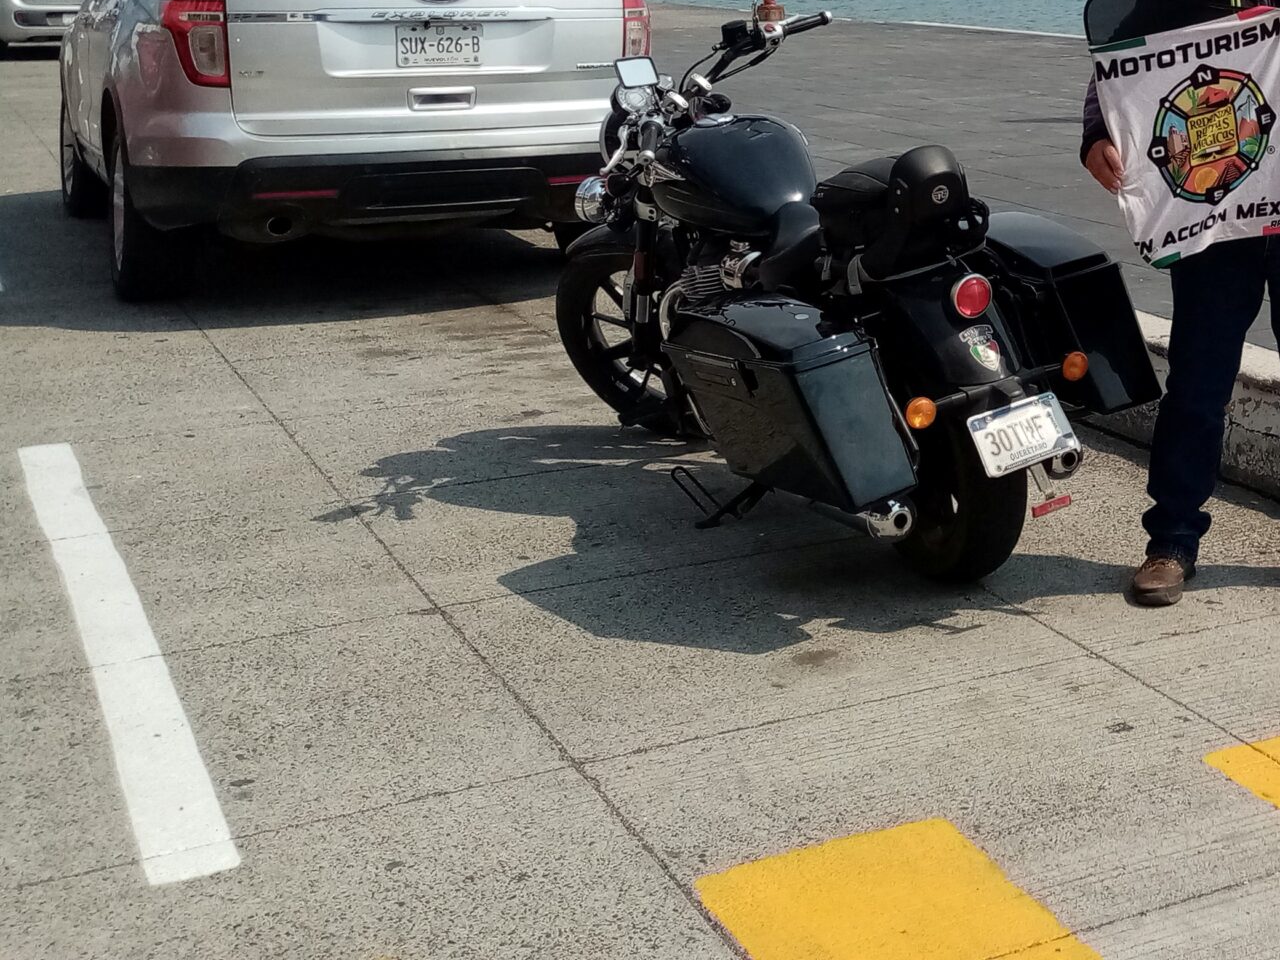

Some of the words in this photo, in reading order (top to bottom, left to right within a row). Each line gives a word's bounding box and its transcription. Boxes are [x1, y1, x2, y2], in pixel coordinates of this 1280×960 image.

[371, 10, 510, 19] EXPLORER
[400, 36, 480, 54] SUX-626-B
[1196, 70, 1212, 81] N
[1261, 113, 1272, 124] E
[1151, 146, 1165, 158] O
[1213, 190, 1224, 200] S
[1162, 208, 1227, 248] ACCIÓN
